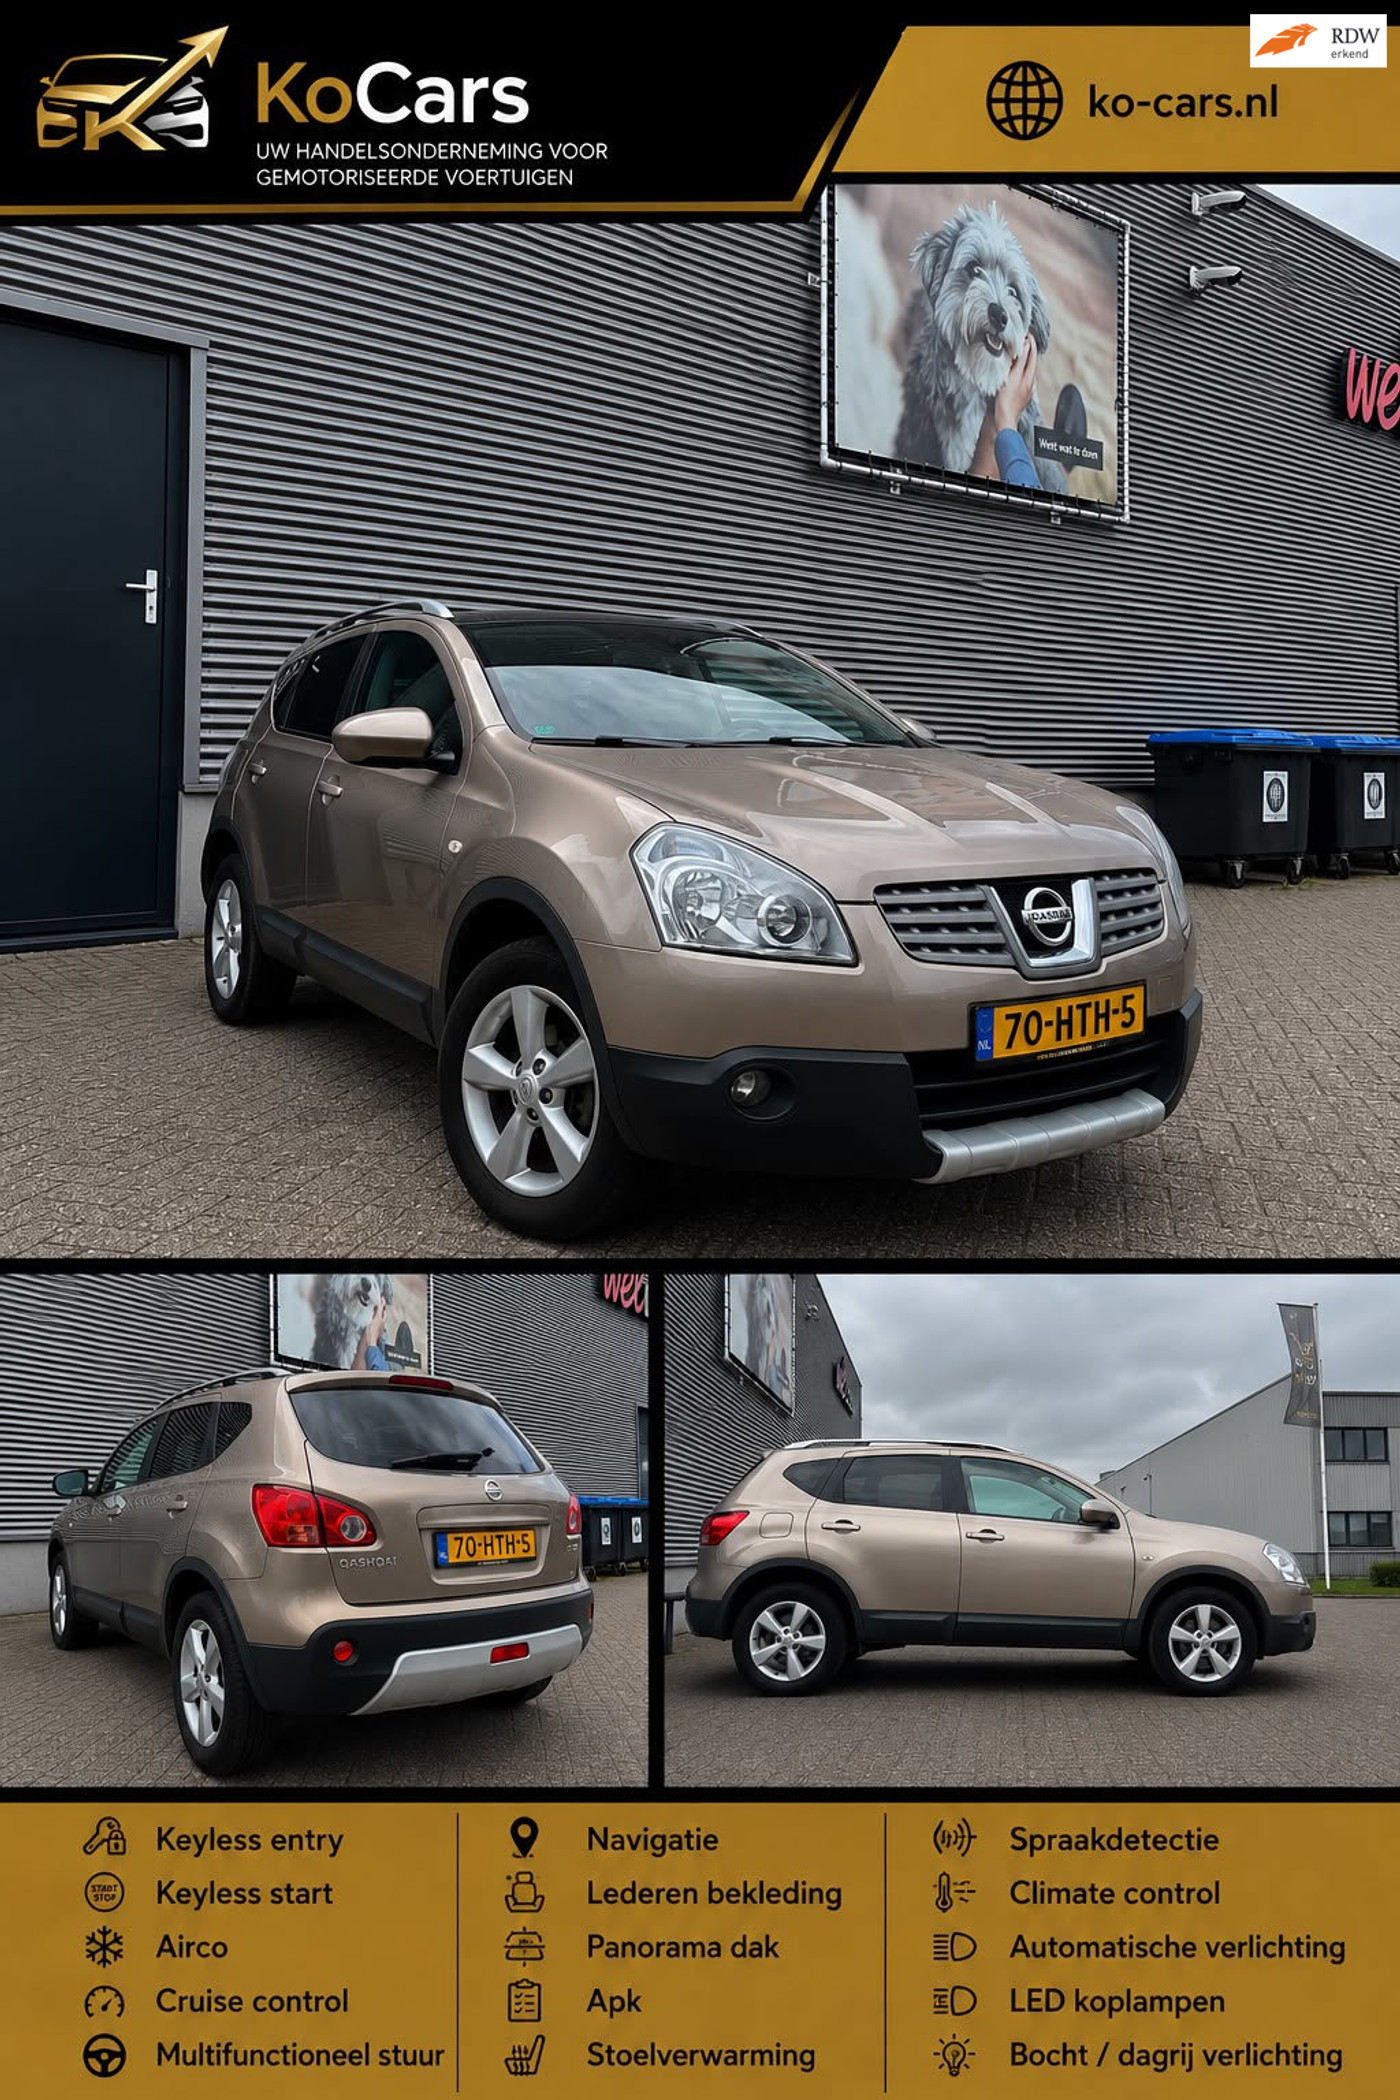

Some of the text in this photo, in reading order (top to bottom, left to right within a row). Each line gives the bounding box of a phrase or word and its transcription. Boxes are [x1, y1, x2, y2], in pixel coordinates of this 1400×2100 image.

[1004, 993, 1136, 1050] 70-HTH-5
[977, 1039, 992, 1051] NL
[453, 1533, 531, 1559] 70-HTH-5
